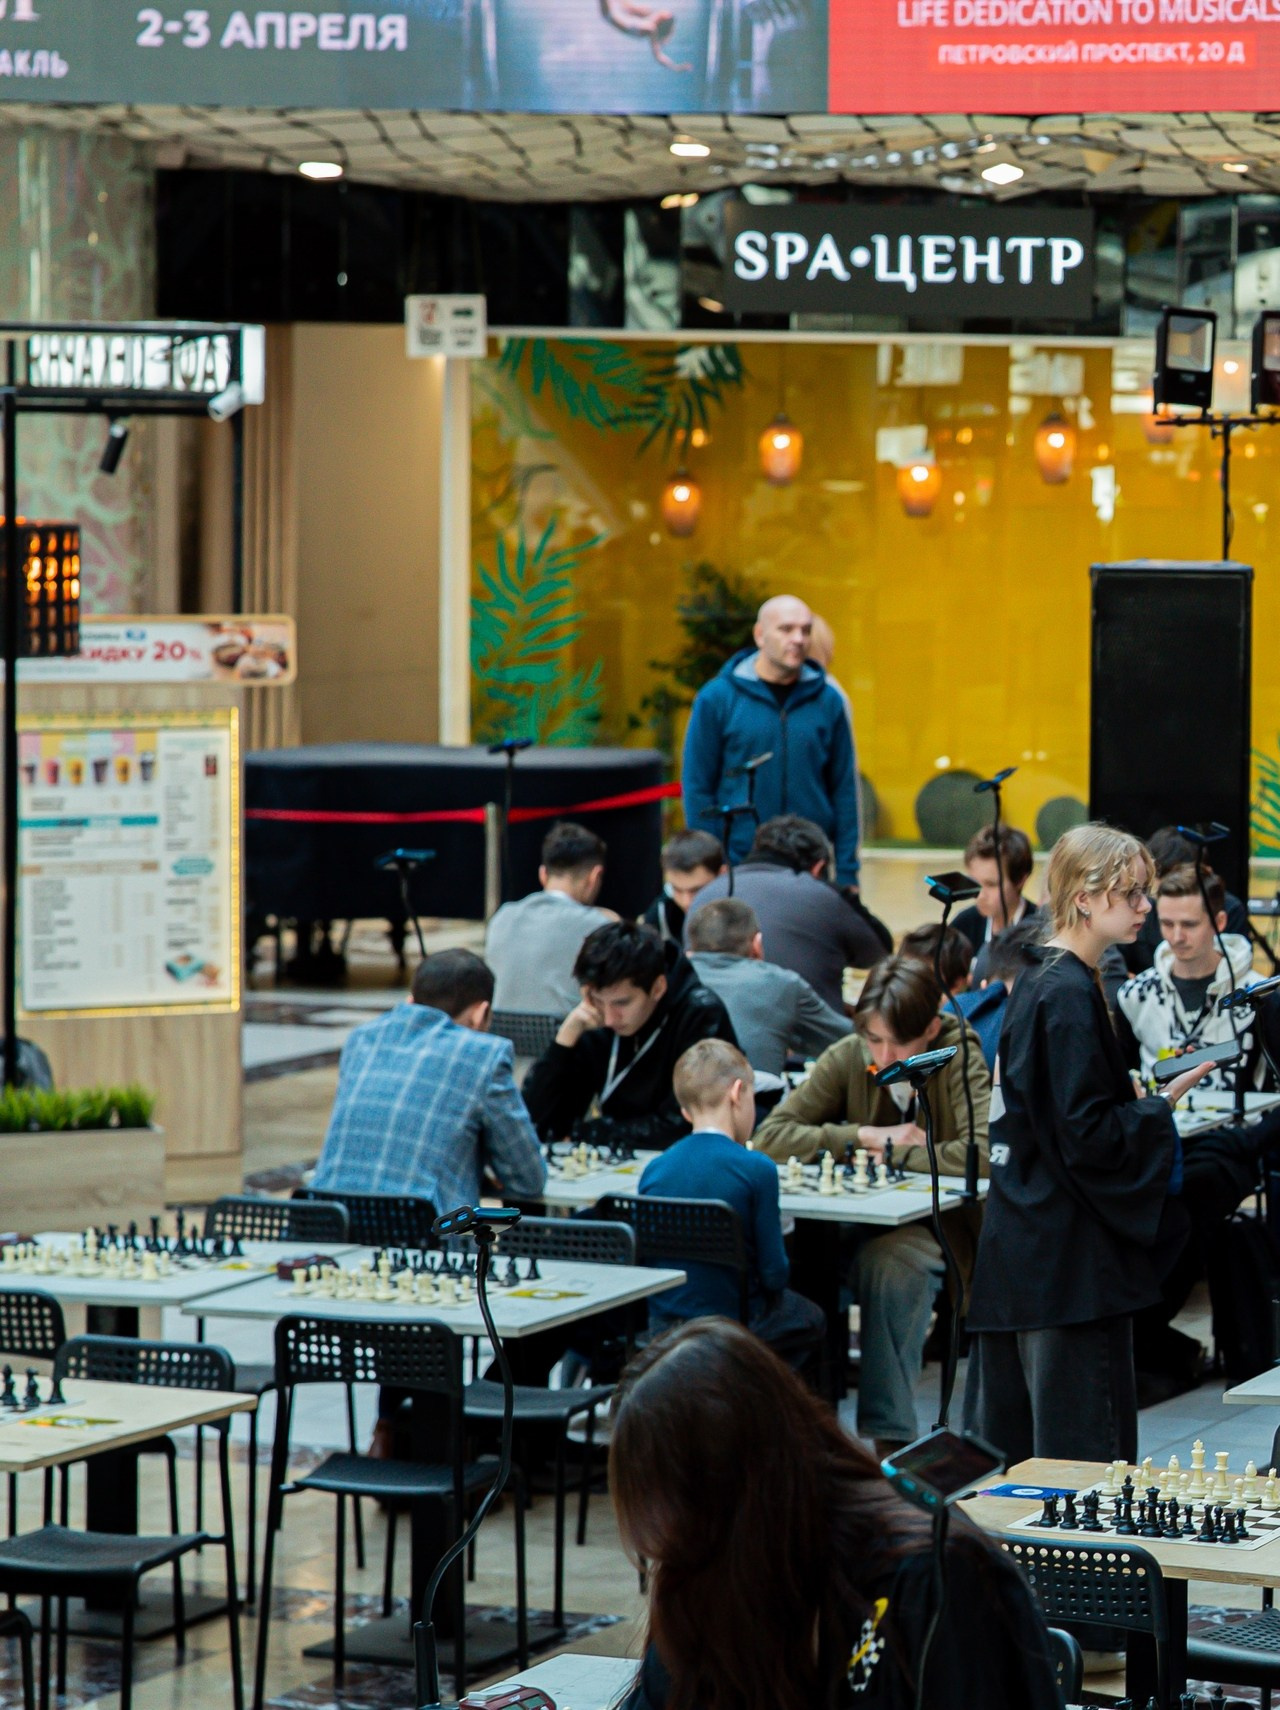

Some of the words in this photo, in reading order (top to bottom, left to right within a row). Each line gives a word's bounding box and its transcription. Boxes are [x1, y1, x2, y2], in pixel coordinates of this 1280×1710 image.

[897, 0, 949, 27] LIFE
[953, 0, 1114, 27] DEDICATION
[1118, 0, 1155, 25] TO
[136, 9, 211, 48] 2-3
[220, 11, 408, 51] АПРЕЛЯ
[938, 40, 1078, 65] ПЕТРОВСКИЙ
[1197, 41, 1225, 62] 20
